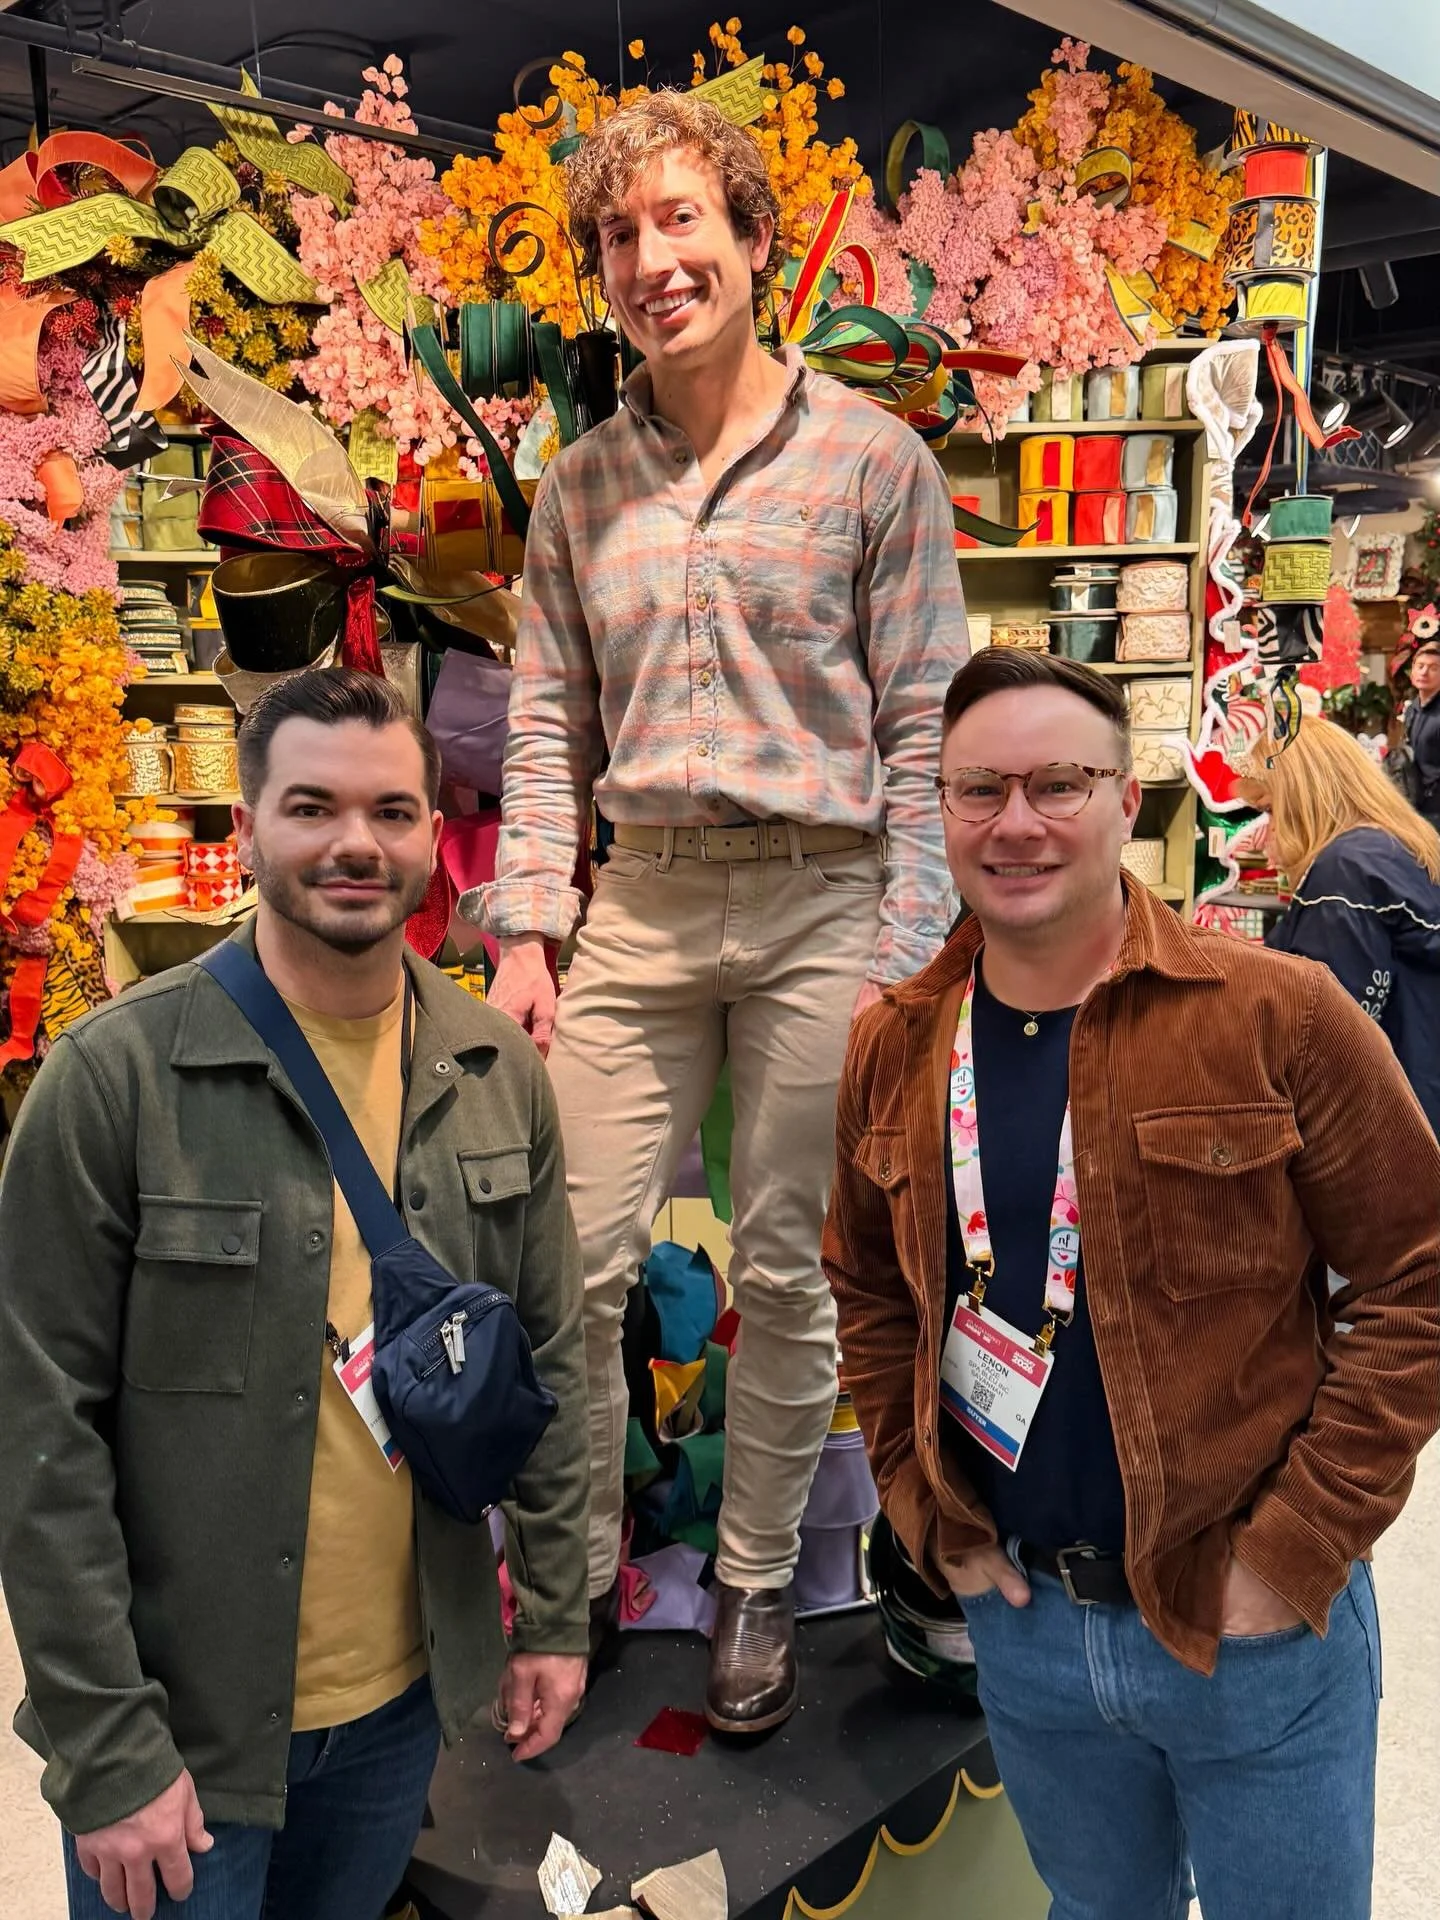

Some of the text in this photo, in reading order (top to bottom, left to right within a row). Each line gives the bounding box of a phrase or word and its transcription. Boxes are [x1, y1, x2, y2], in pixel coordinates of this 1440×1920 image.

[977, 1350, 1009, 1377] LENON
[980, 1362, 1001, 1378] PAGE
[970, 1369, 1004, 1398] SAVANNAH
[1015, 1413, 1026, 1426] GA
